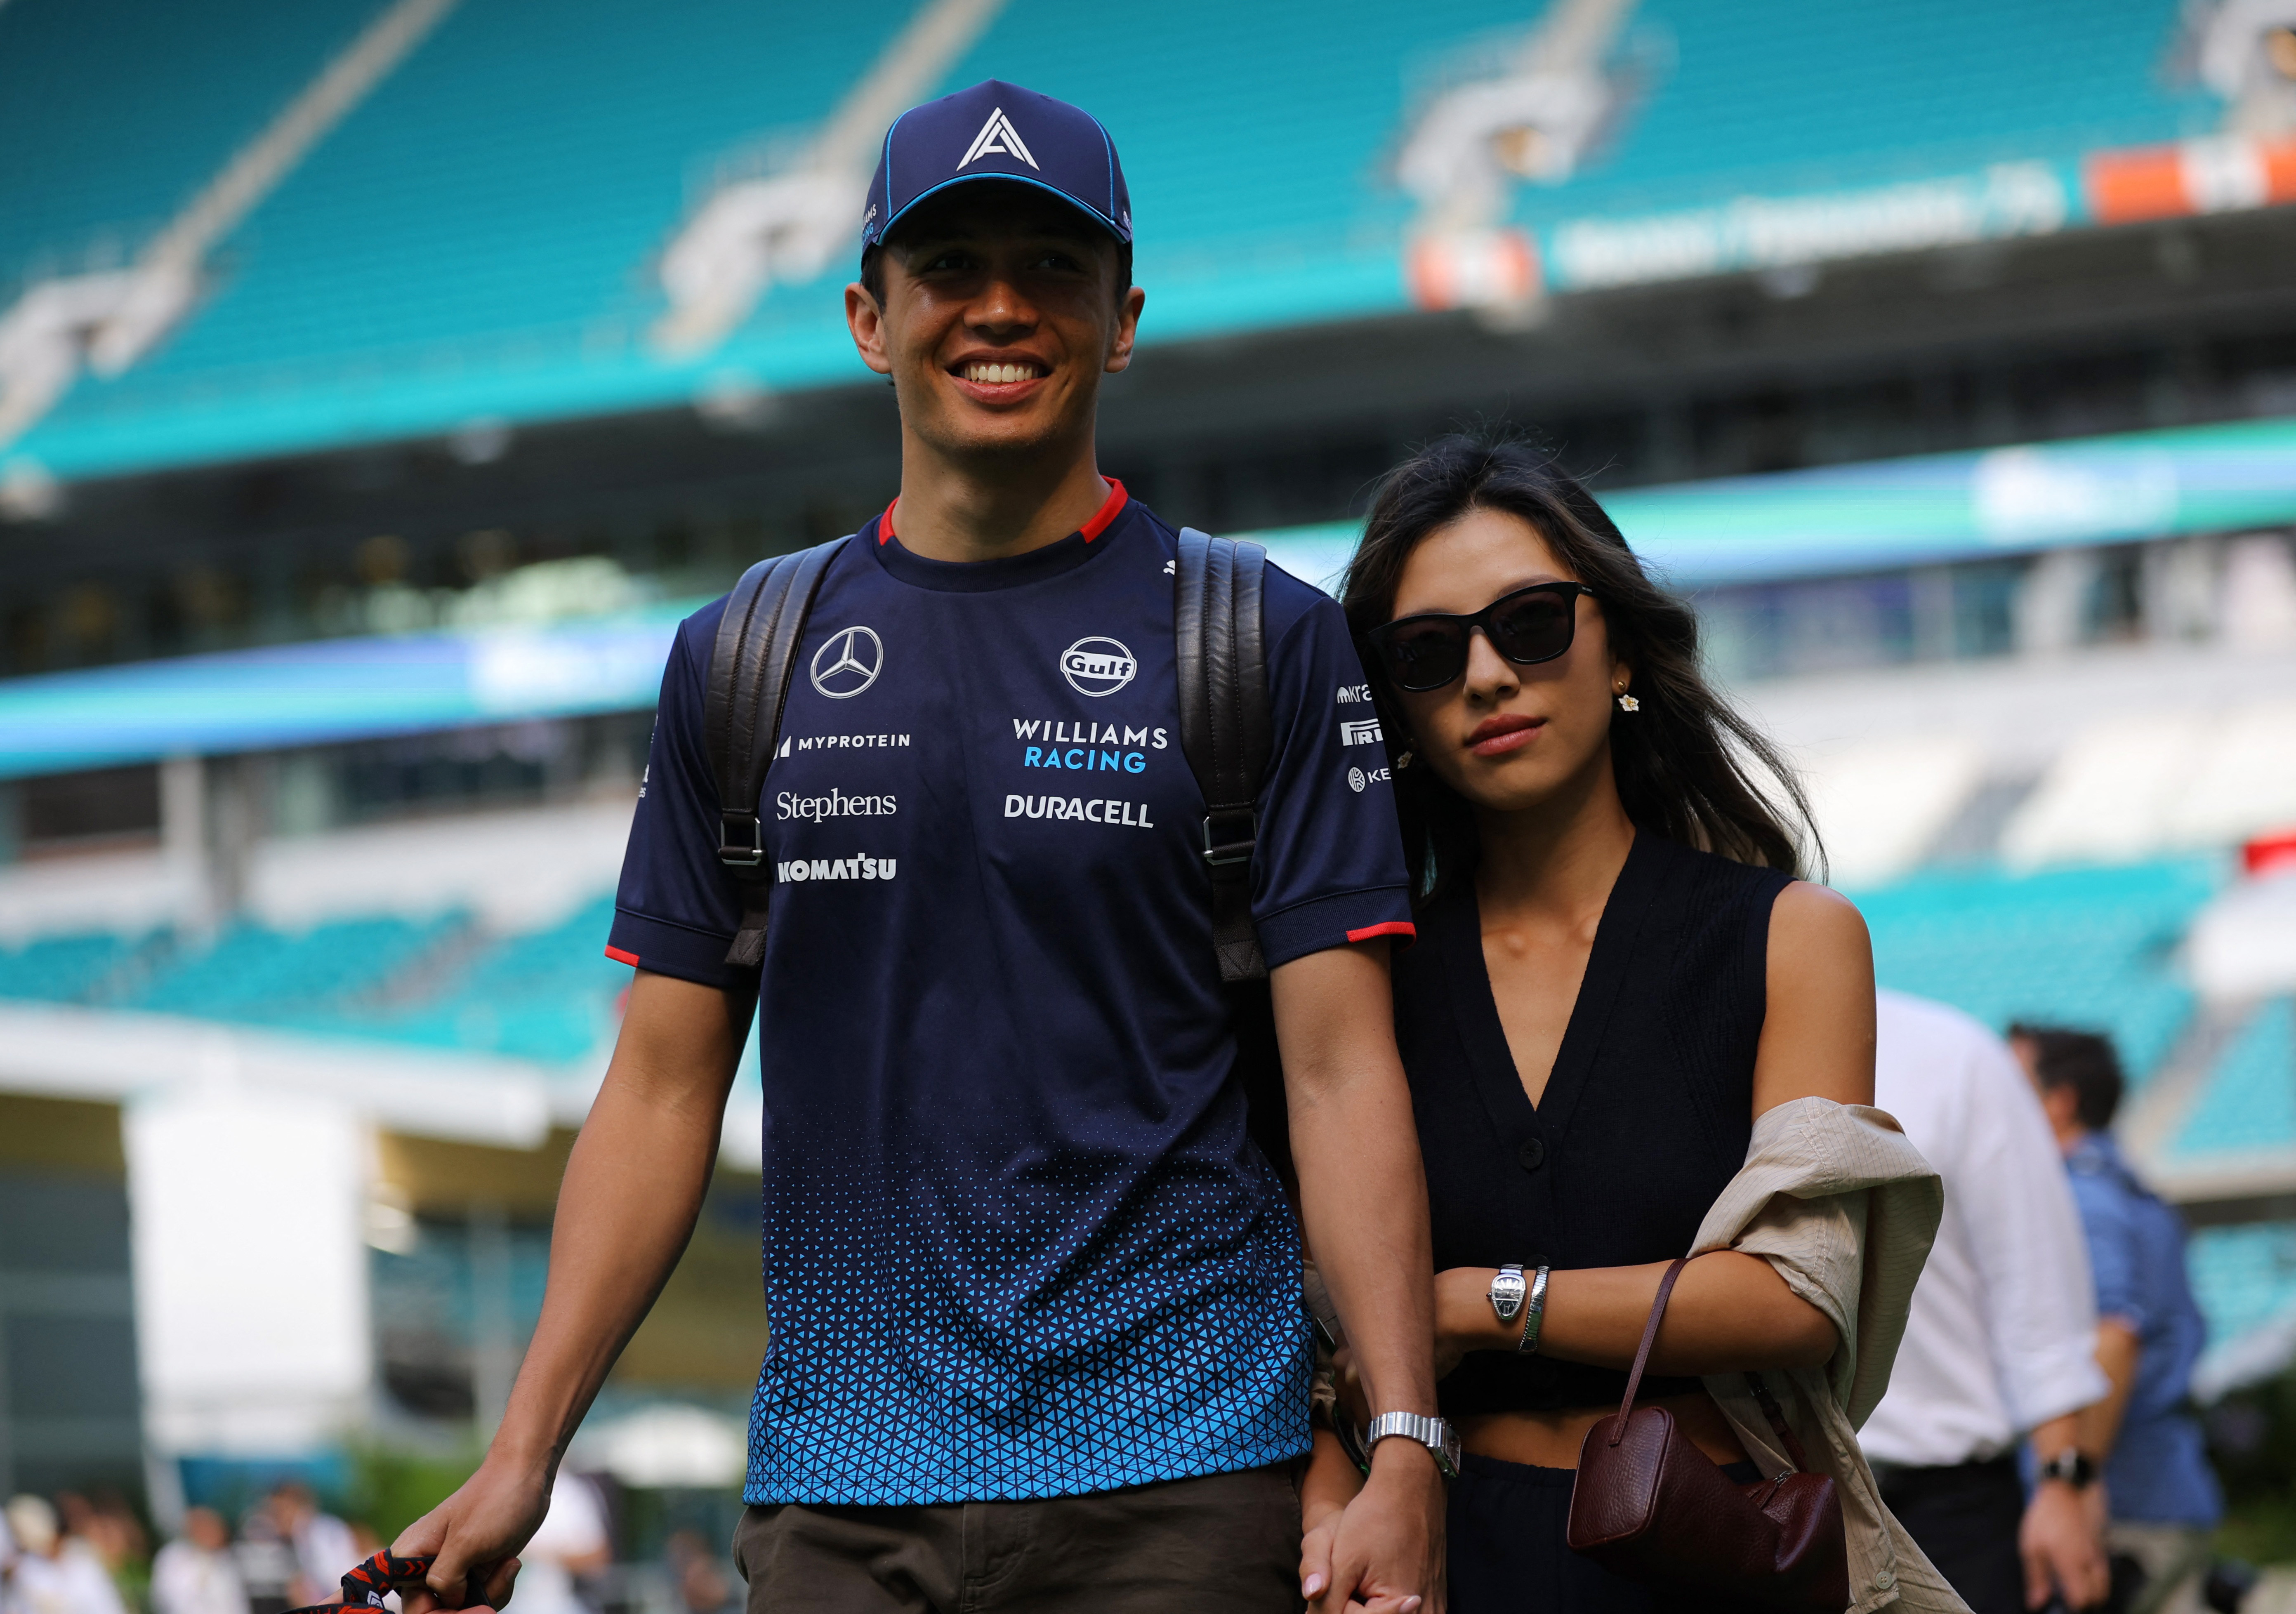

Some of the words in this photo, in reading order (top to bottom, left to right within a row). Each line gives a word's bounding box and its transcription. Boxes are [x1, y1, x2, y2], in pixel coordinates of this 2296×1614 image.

[1066, 654, 1131, 676] Gulf
[798, 734, 910, 751] MYPROTEIN
[1013, 718, 1168, 749] WILLIAMS
[1024, 746, 1146, 774] RACING
[776, 787, 897, 823] Stephens
[1004, 794, 1154, 829] DURACELL
[778, 852, 897, 883] KOMATSU
